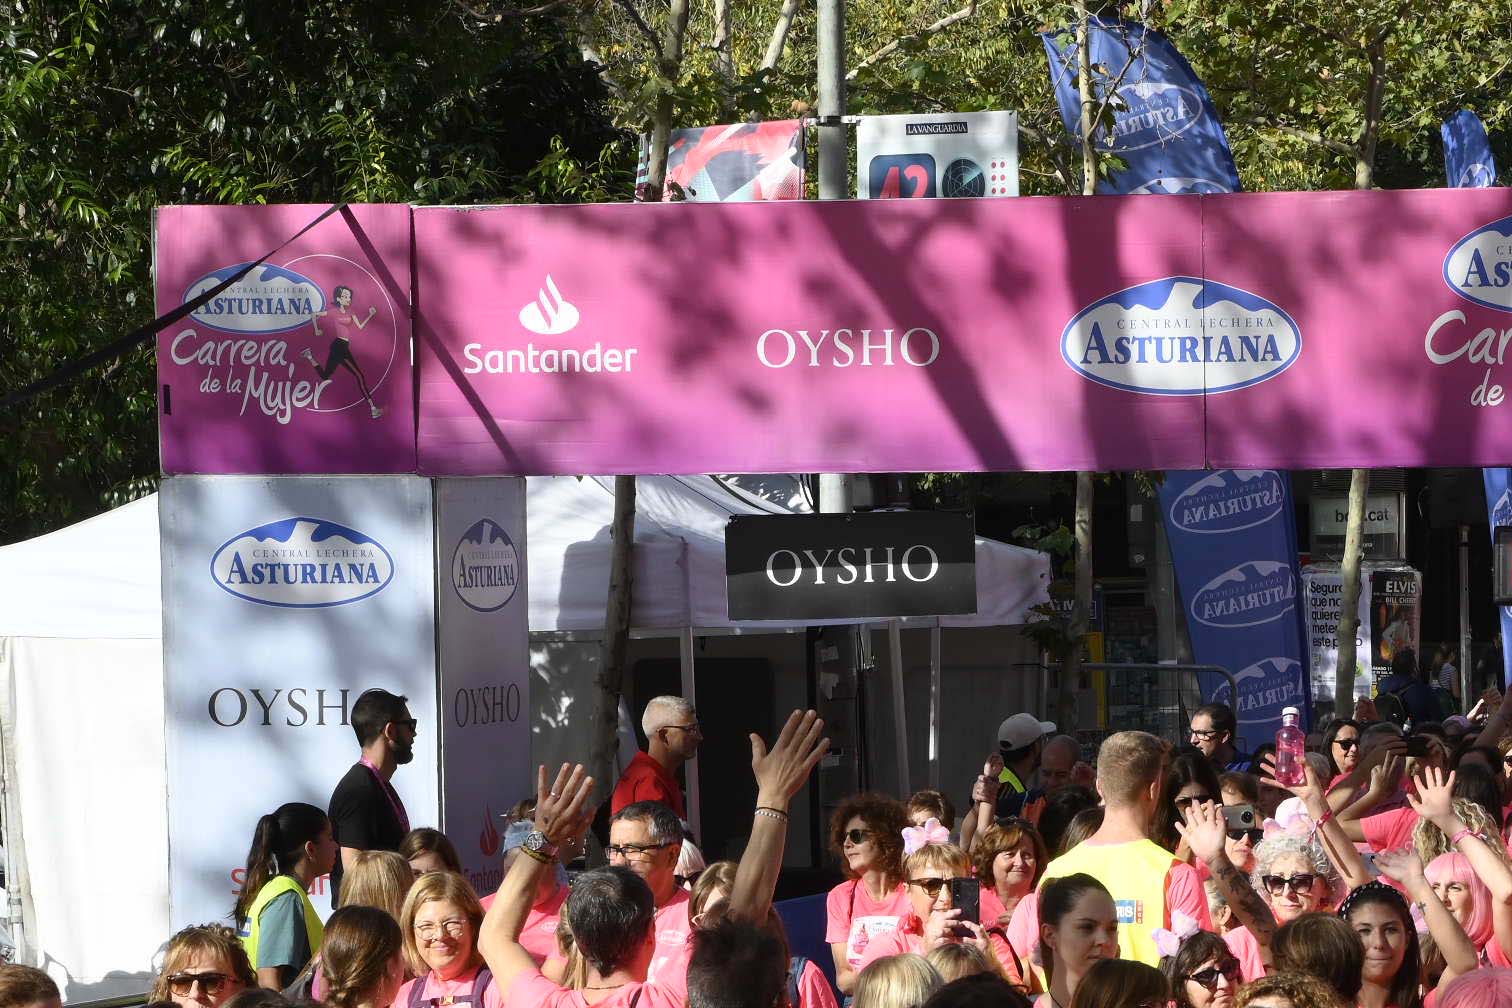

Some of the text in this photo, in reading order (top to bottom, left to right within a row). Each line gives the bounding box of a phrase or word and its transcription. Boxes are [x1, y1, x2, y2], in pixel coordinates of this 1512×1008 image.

[917, 123, 966, 133] VANGUARDIA
[1116, 316, 1275, 330] CENTRAL LECHERA
[171, 328, 289, 366] Carrera
[463, 342, 638, 375] Santander
[757, 327, 941, 369] OYSHO
[1080, 321, 1283, 365] ASTURIANA
[200, 363, 333, 425] de la Mujer
[1470, 369, 1505, 407] de
[225, 551, 381, 586] ASTURIANA
[253, 549, 375, 559] CENTRAL LECHERA
[766, 545, 940, 587] OYSHO
[457, 562, 515, 590] ASTURIANA
[1385, 580, 1416, 593] ELVIS
[208, 687, 389, 728] OYSH
[454, 683, 521, 729] OYSHO
